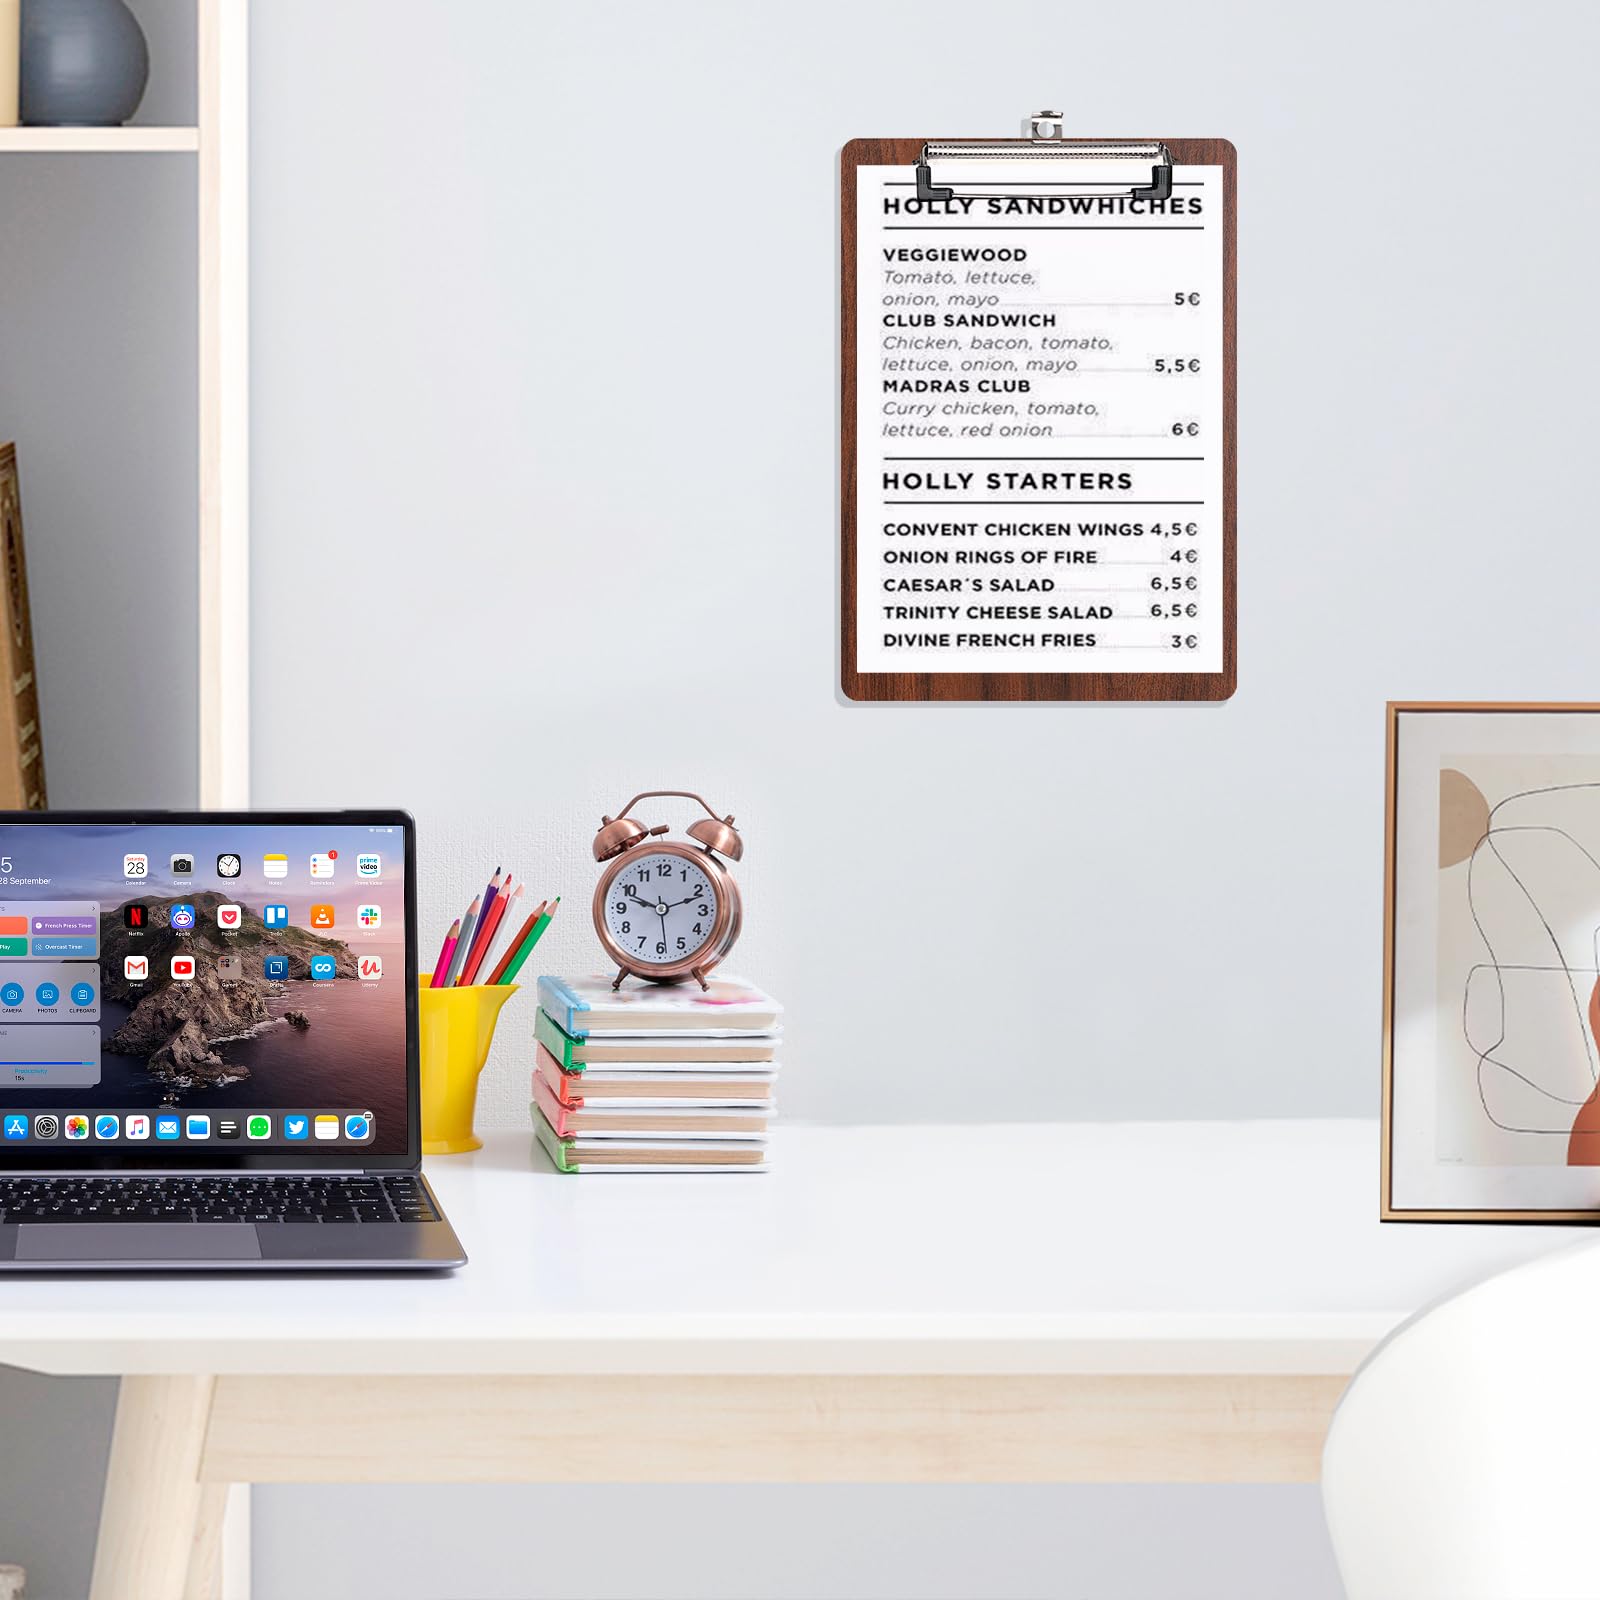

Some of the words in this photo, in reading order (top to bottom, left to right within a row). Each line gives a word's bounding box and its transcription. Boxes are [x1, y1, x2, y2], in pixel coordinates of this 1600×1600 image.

[883, 197, 974, 216] HOLLY
[987, 196, 1204, 216] SANDWHICHES
[883, 247, 1028, 263] VEGGIEWOOD
[884, 270, 957, 286] Tomato,
[965, 270, 1036, 286] lettuce,
[882, 292, 940, 308] onion,
[948, 295, 1000, 309] mayo
[882, 313, 937, 328] CLUB
[944, 313, 1056, 328] SANDWICH
[882, 335, 962, 352] Chicken,
[970, 335, 1033, 352] bacon,
[1040, 336, 1114, 352] tomato,
[882, 357, 953, 373] lettuce,
[960, 357, 1018, 373] onion,
[1026, 360, 1078, 375] mayo
[882, 379, 971, 394] MADRAS
[977, 379, 1031, 394] CLUB
[882, 401, 937, 418] Curry
[941, 401, 1019, 417] chicken,
[1027, 402, 1100, 417] tomato,
[882, 423, 954, 439] lettuce,
[960, 423, 994, 438] red
[1000, 424, 1053, 438] onion
[882, 472, 975, 491] HOLLY
[986, 472, 1133, 491] STARTERS
[882, 522, 979, 537] CONVENT
[984, 522, 1072, 537] CHICKEN
[1077, 522, 1145, 537] WINGS
[882, 550, 949, 565] ONION
[956, 550, 1016, 565] RINGS
[1020, 550, 1049, 565] OF
[1053, 550, 1098, 565] FIRE
[989, 578, 1055, 593] SALAD
[882, 605, 961, 620] TRINITY
[965, 605, 1042, 620] CHEESE
[1047, 605, 1114, 620] SALAD
[883, 632, 951, 648] DIVINE
[955, 632, 1036, 648] FRENCH
[1040, 632, 1097, 648] FRIES
[0, 856, 13, 874] 5
[359, 856, 378, 864] prime
[127, 862, 145, 875] 28
[637, 869, 650, 882] 11
[656, 864, 672, 877] 12
[680, 869, 687, 882] 1
[9, 877, 52, 886] September
[622, 884, 637, 897] 10
[693, 884, 705, 897] 2
[616, 902, 627, 914] 9
[697, 904, 709, 917] 3
[621, 921, 631, 934] 8
[692, 923, 702, 936] 4
[637, 936, 647, 949] 7
[656, 942, 666, 955] 6
[676, 937, 686, 950] 5
